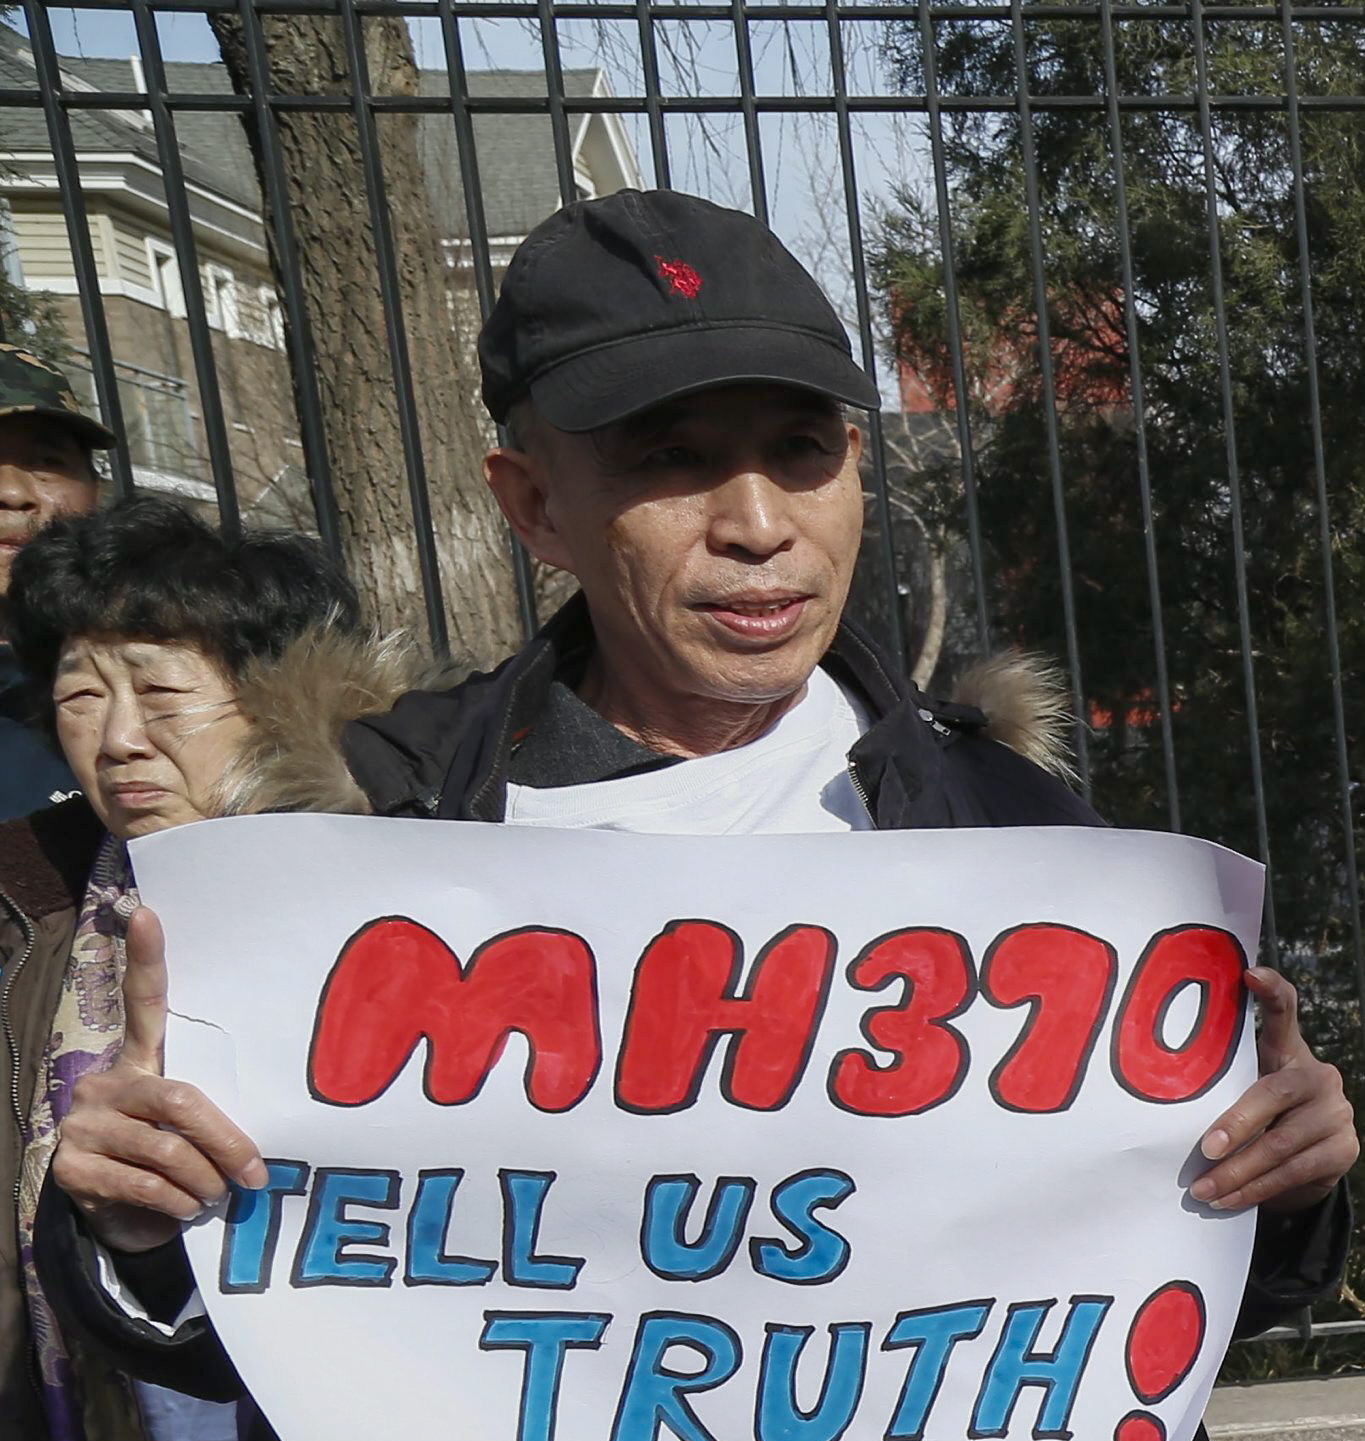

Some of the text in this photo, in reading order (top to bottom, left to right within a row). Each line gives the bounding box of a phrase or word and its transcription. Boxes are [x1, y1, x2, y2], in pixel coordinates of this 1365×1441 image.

[308, 915, 1245, 1118] MH370
[218, 1157, 857, 1295] TELL US
